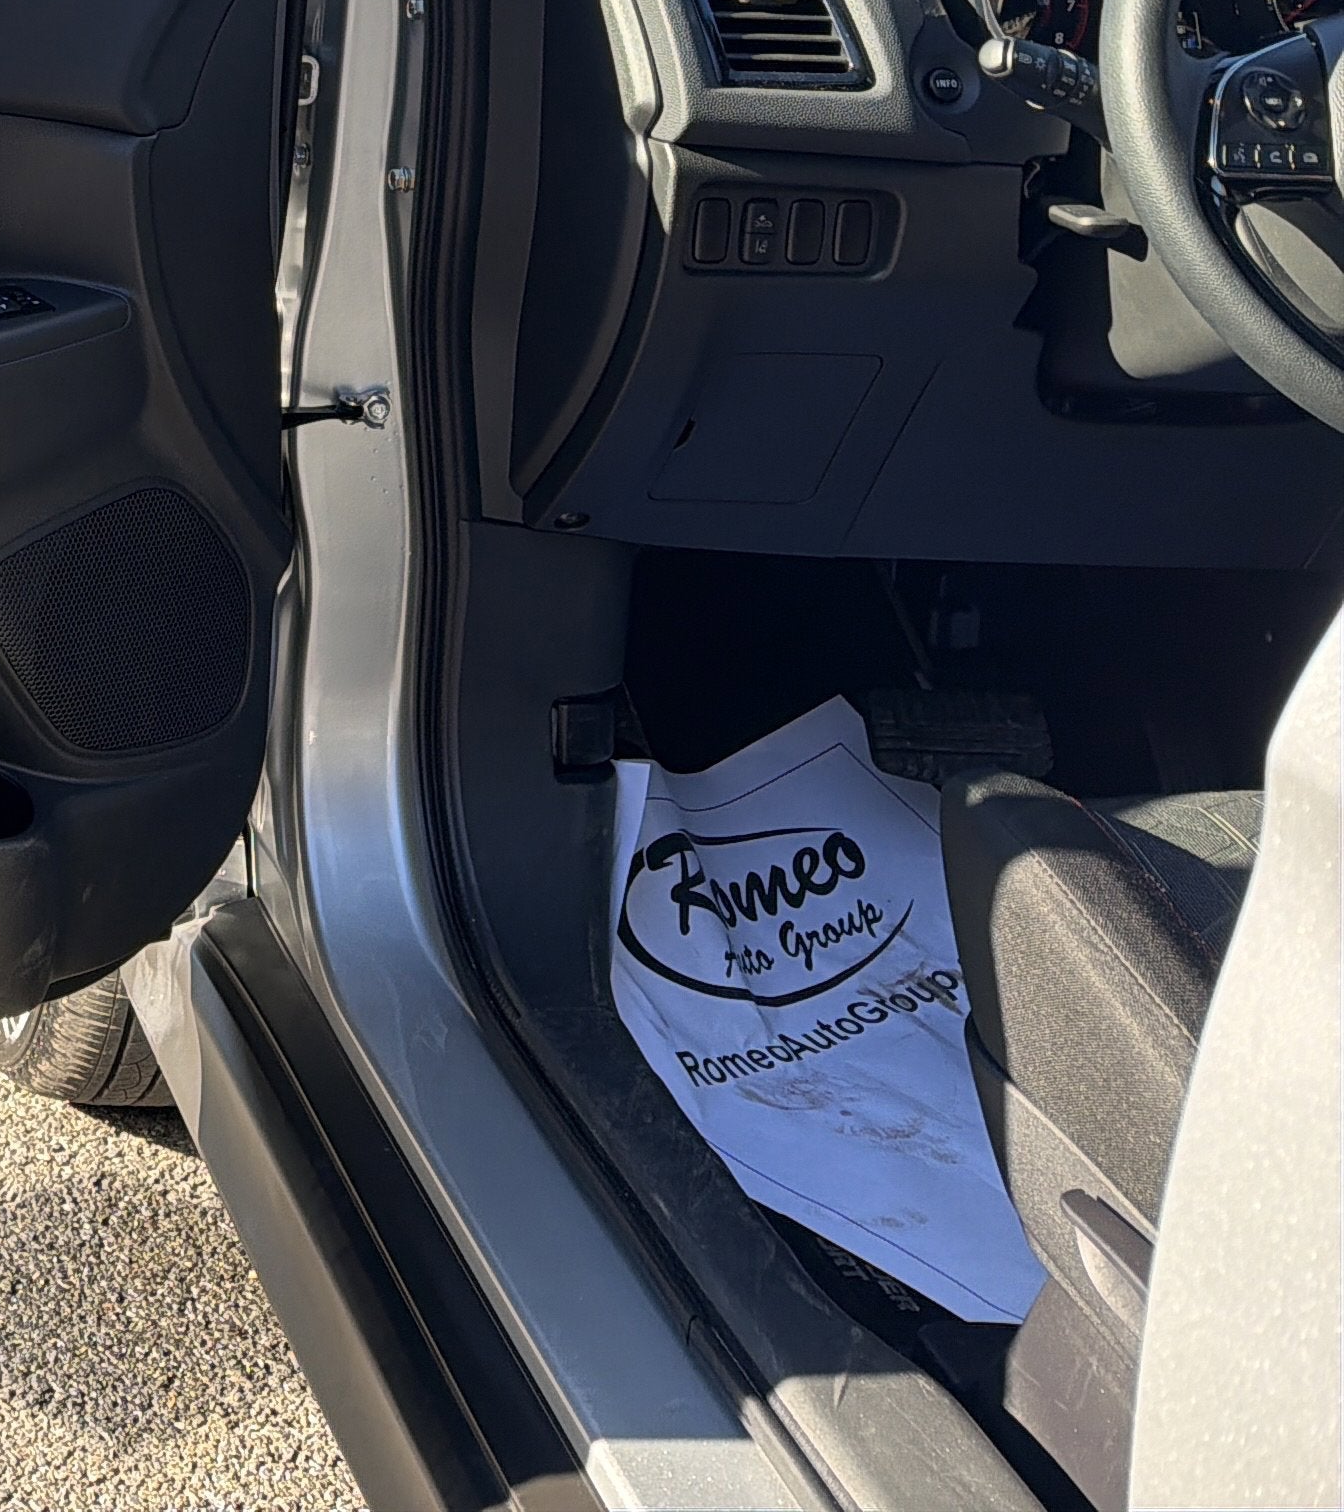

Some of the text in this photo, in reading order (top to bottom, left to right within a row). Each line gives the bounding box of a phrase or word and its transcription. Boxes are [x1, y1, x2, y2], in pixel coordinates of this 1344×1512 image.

[1066, 0, 1076, 12] 7
[1054, 32, 1064, 45] 8
[935, 78, 958, 88] INFO
[645, 832, 866, 936] Romeo
[778, 898, 884, 972] Group
